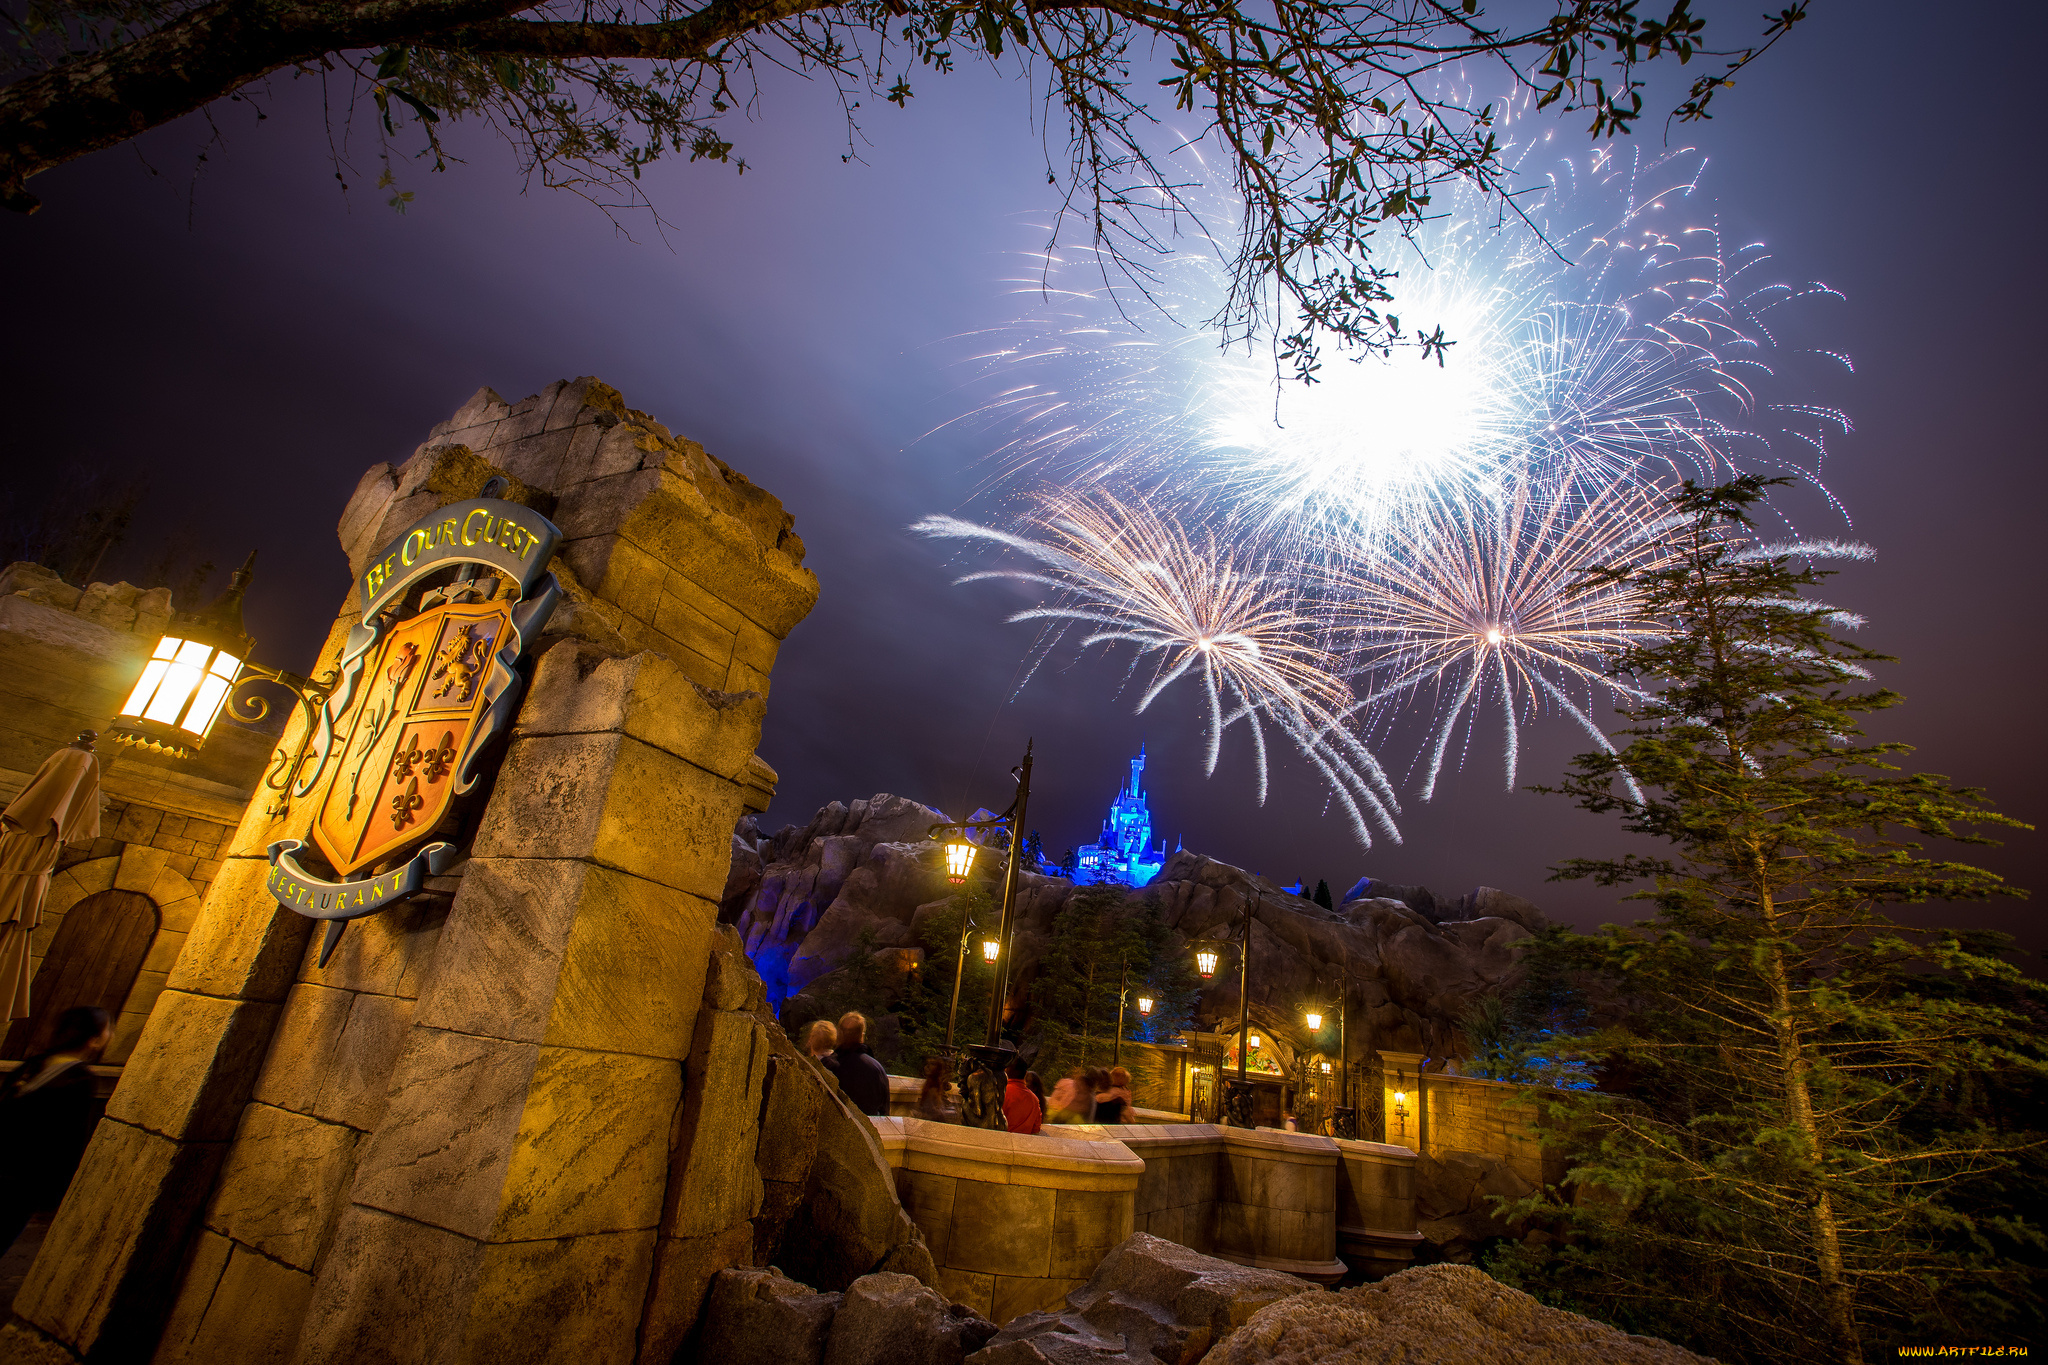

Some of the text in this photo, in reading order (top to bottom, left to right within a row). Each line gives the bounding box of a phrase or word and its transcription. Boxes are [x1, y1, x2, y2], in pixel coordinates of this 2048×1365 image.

[365, 508, 540, 600] BE OUR GUEST
[269, 866, 403, 910] RESTAURANT
